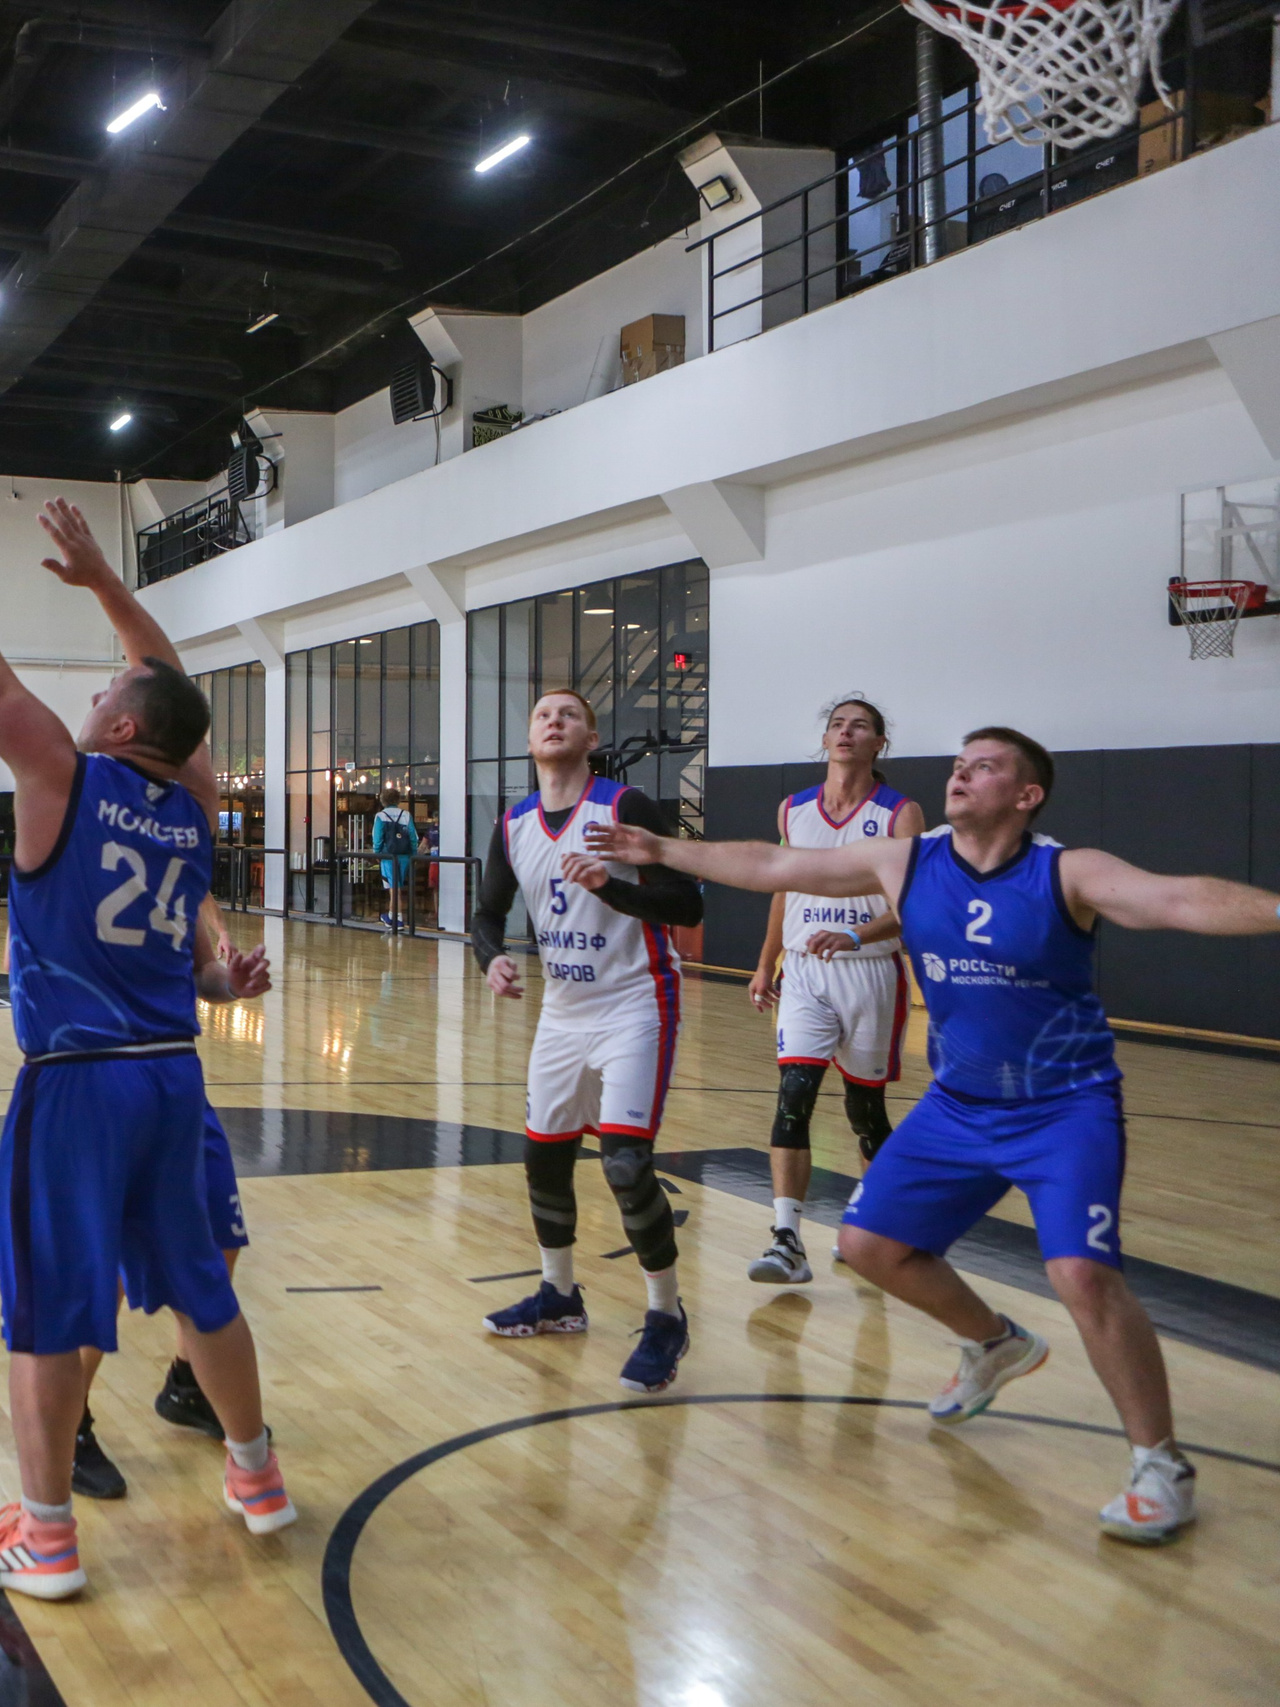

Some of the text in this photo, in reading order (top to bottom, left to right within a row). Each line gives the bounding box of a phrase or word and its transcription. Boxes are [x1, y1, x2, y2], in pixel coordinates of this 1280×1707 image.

[95, 840, 188, 952] 24
[549, 878, 568, 915] 5
[965, 899, 993, 945] 2
[547, 961, 596, 982] САРОВ
[1086, 1203, 1112, 1253] 2
